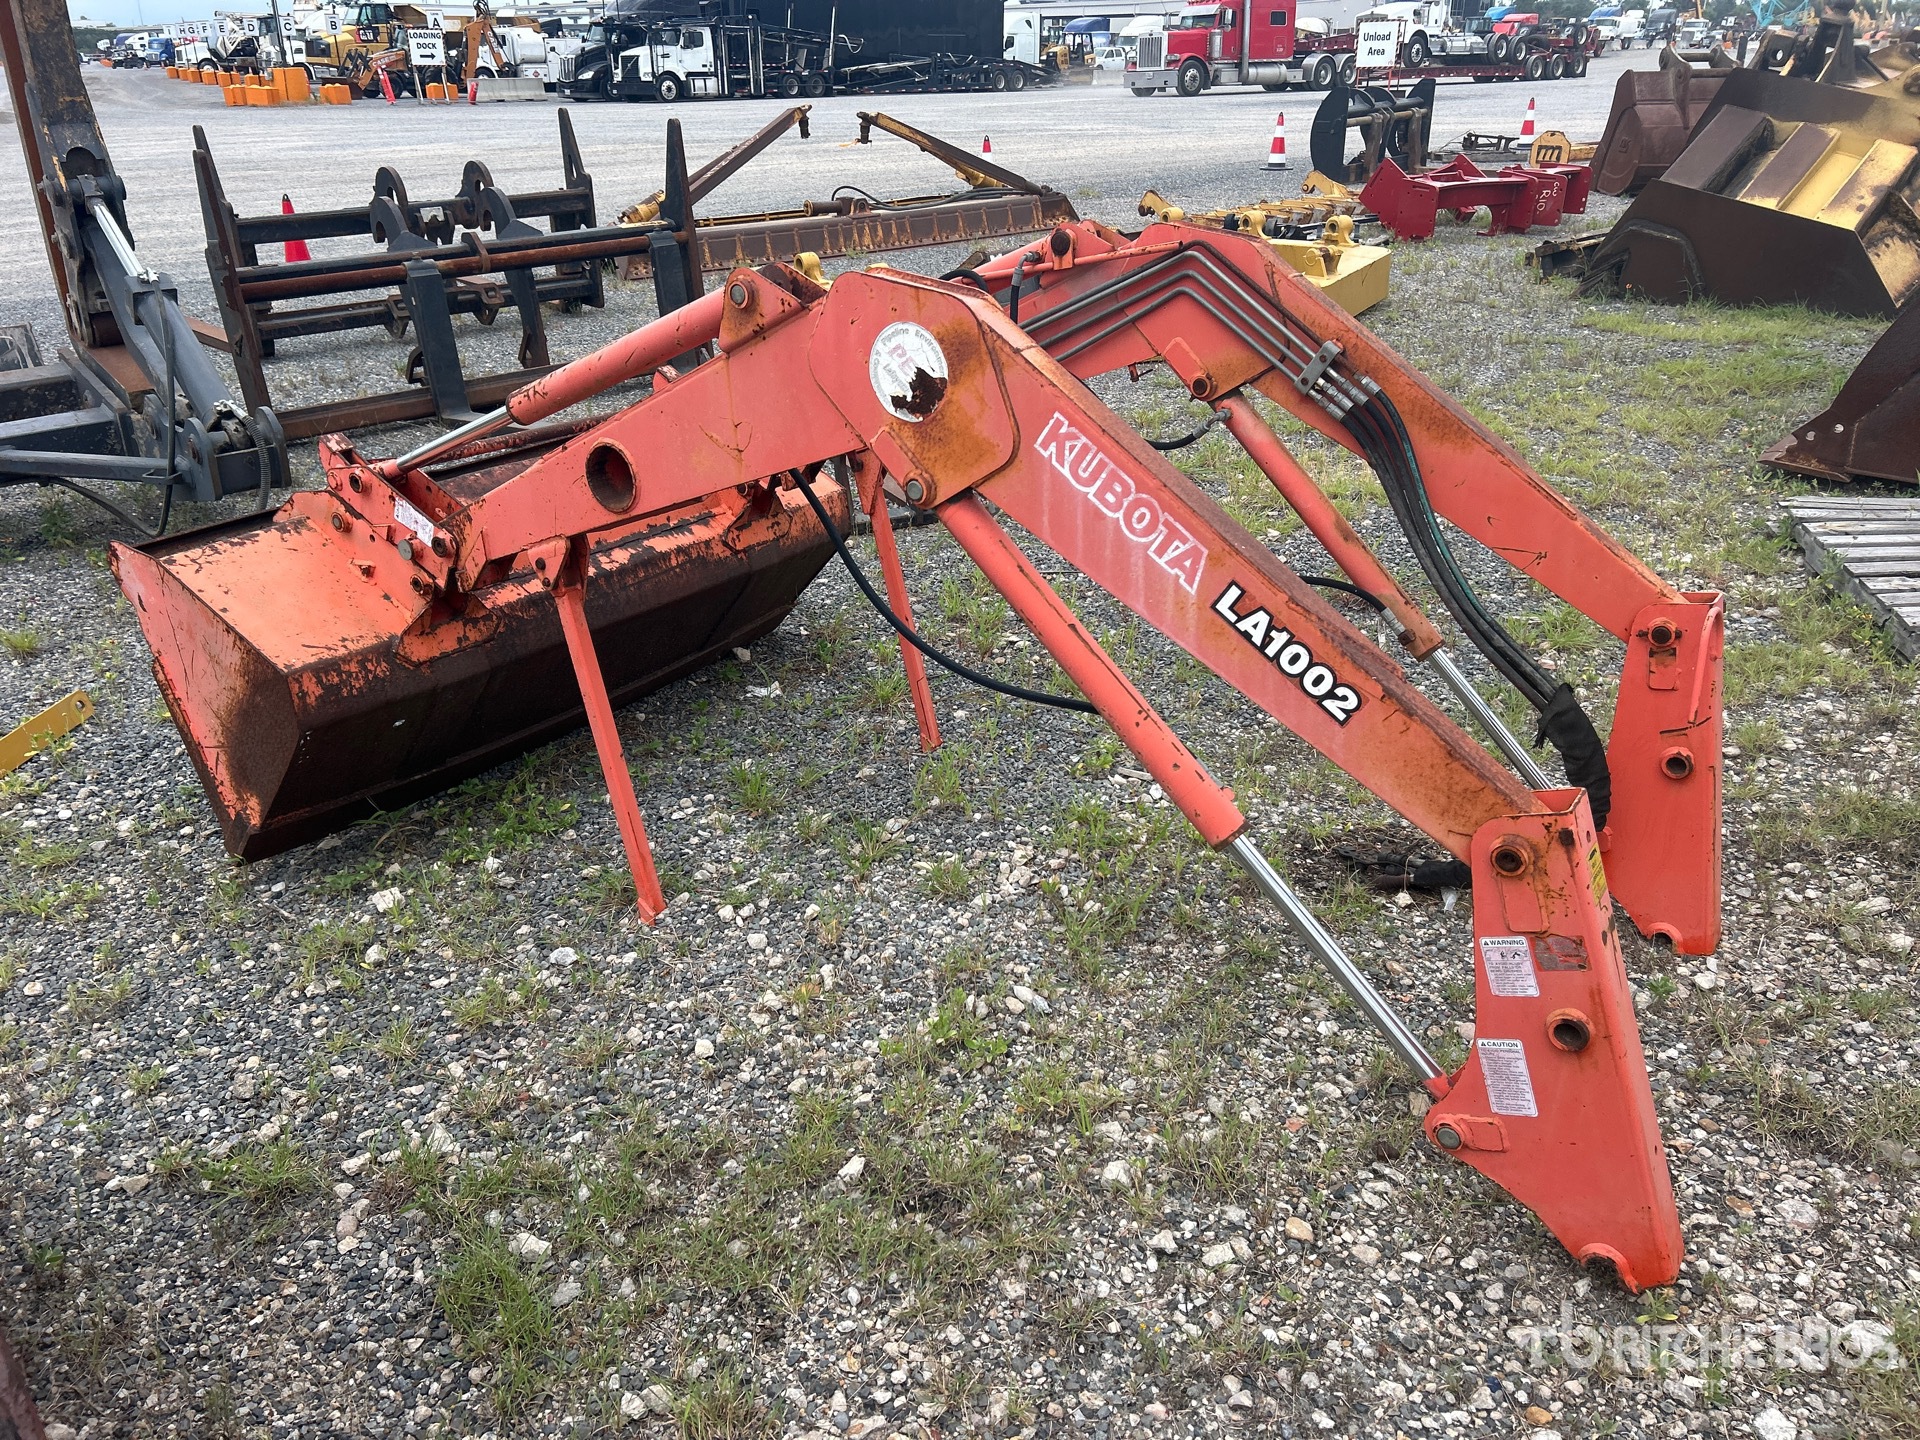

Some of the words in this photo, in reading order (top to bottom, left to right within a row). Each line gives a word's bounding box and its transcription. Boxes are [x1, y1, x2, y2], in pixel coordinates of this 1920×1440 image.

[247, 23, 255, 32] D
[283, 22, 292, 31] C
[330, 20, 338, 30] B
[432, 18, 440, 28] A
[187, 26, 195, 34] G
[202, 25, 207, 33] F
[219, 24, 225, 33] E
[1363, 31, 1391, 42] Unload
[416, 42, 437, 50] DOCK
[1367, 47, 1386, 56] Area
[880, 327, 910, 347] Pipeline
[1033, 411, 1209, 596] KUBOTA
[1211, 580, 1362, 728] LA1002
